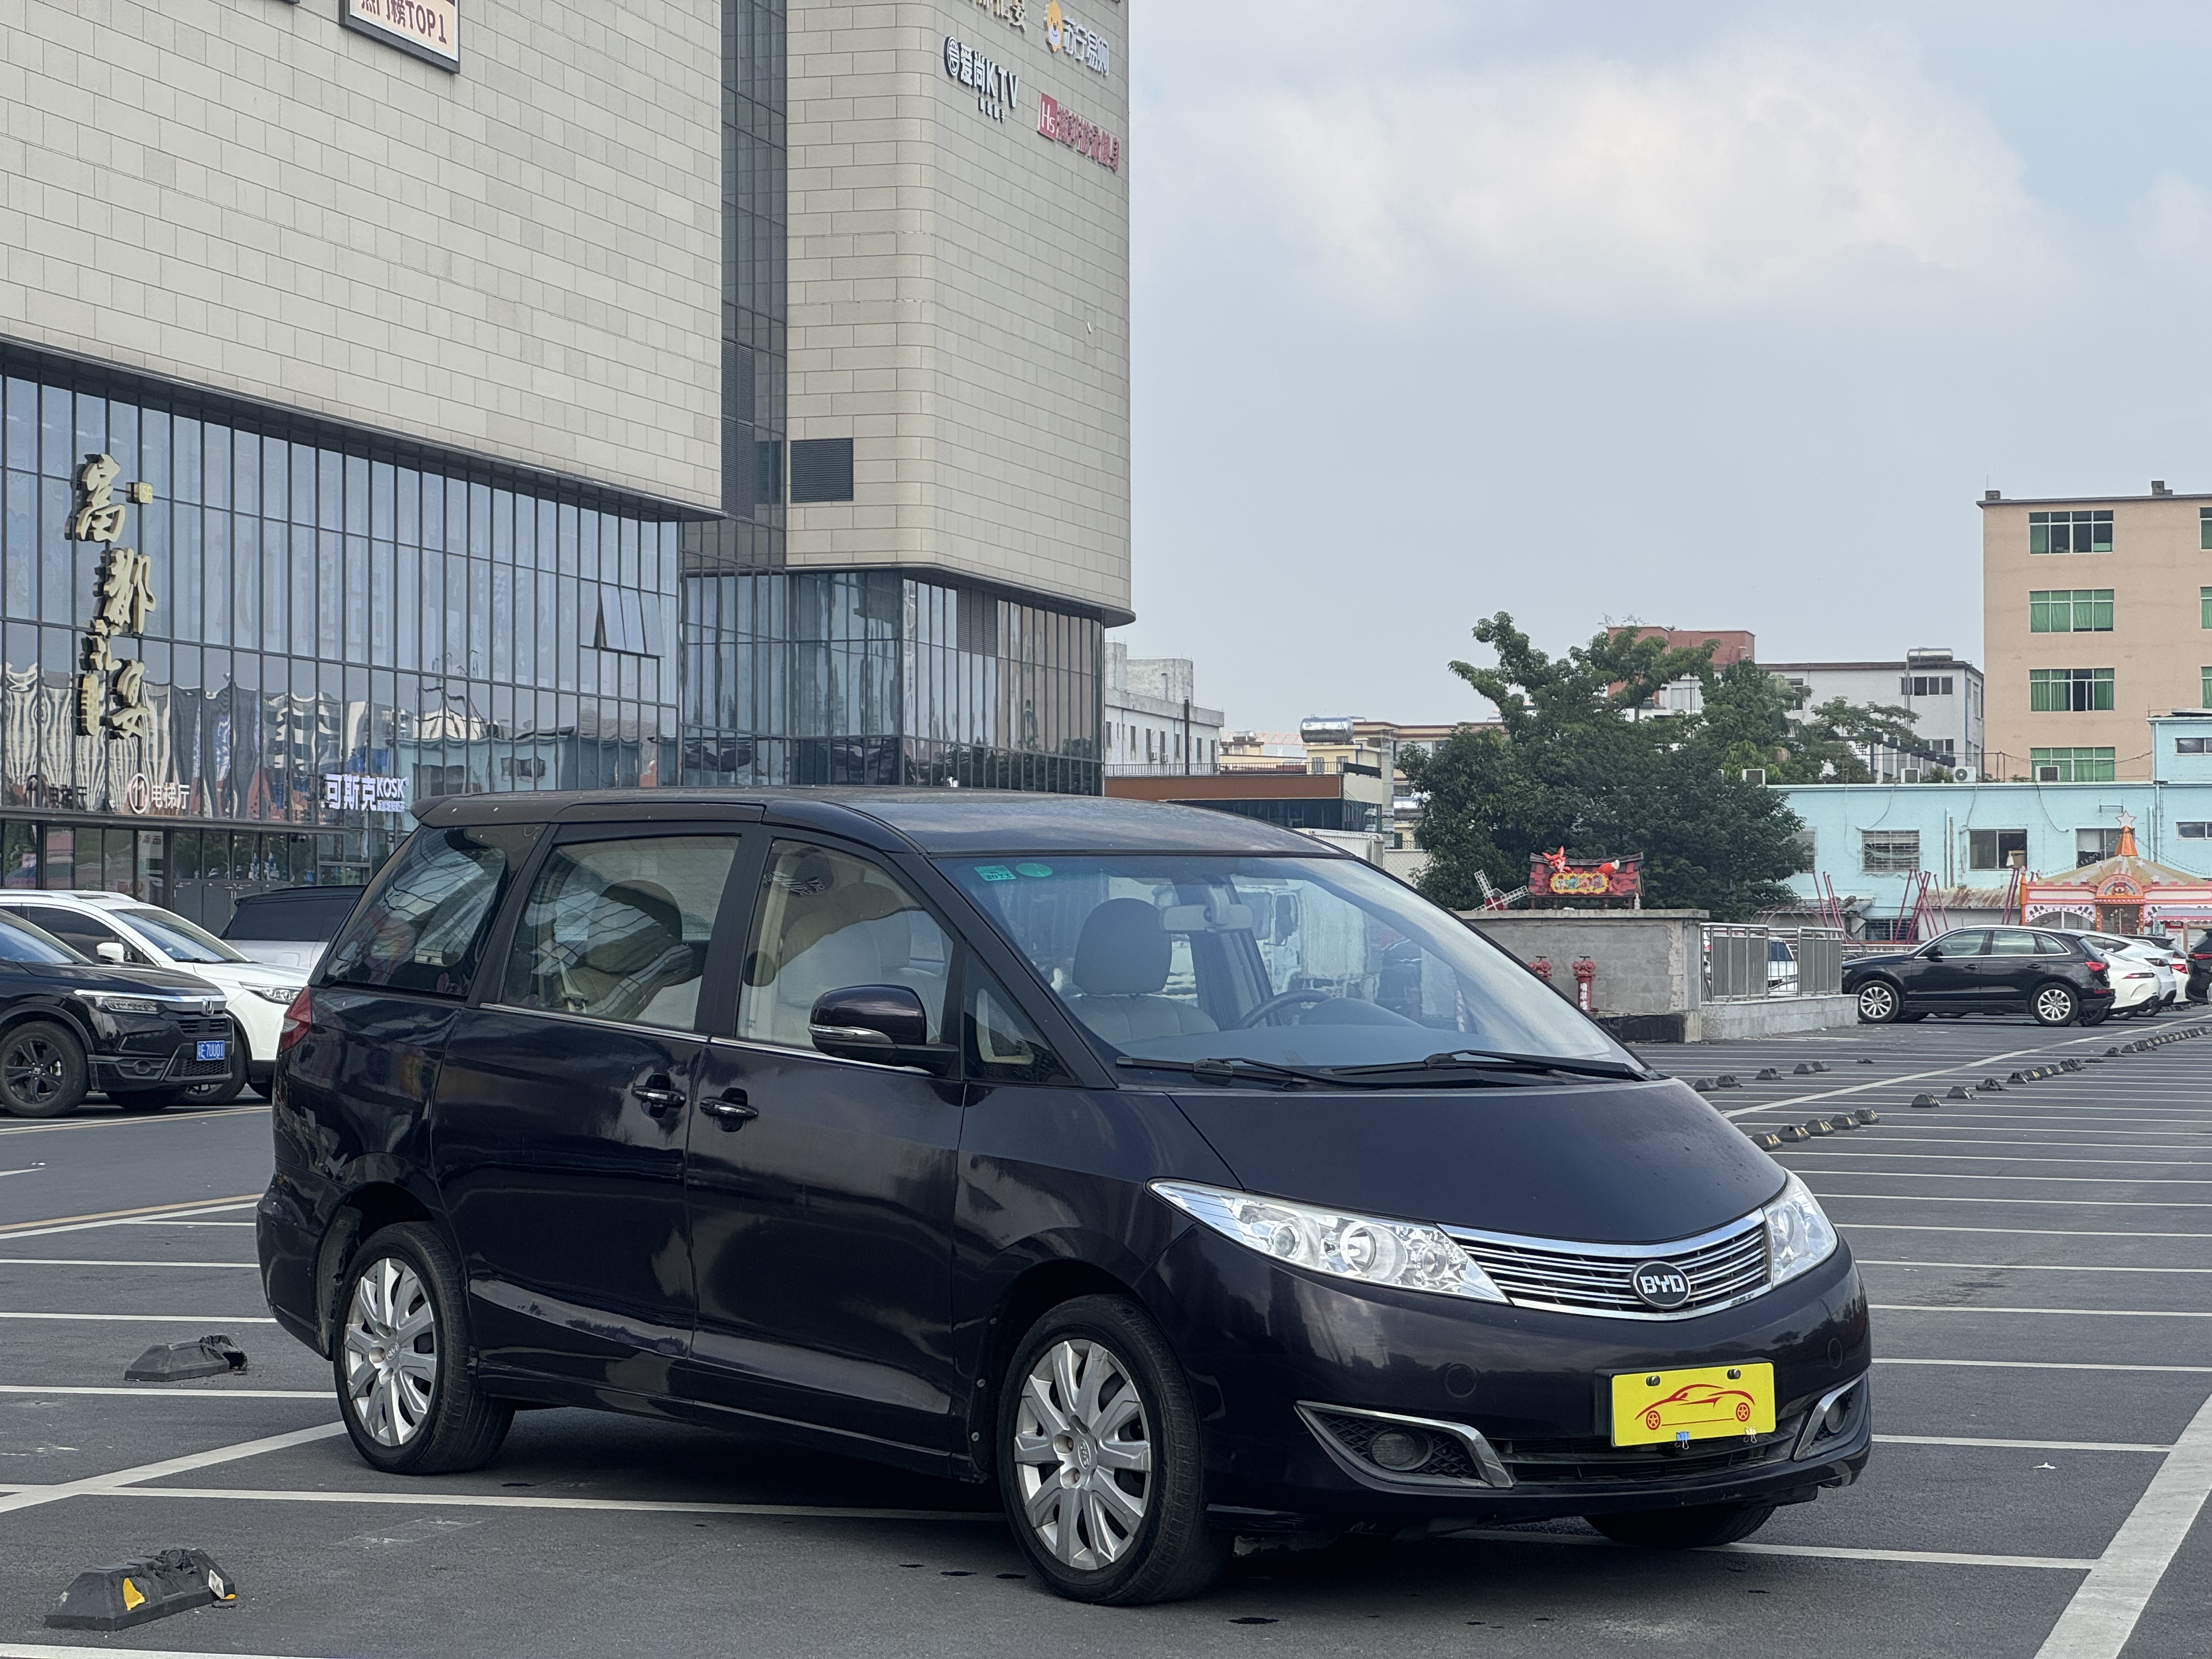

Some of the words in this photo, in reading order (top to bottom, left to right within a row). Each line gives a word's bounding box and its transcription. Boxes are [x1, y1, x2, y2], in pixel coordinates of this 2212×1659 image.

[151, 783, 190, 810] 电梯厅
[1639, 1274, 1686, 1294] BYD
